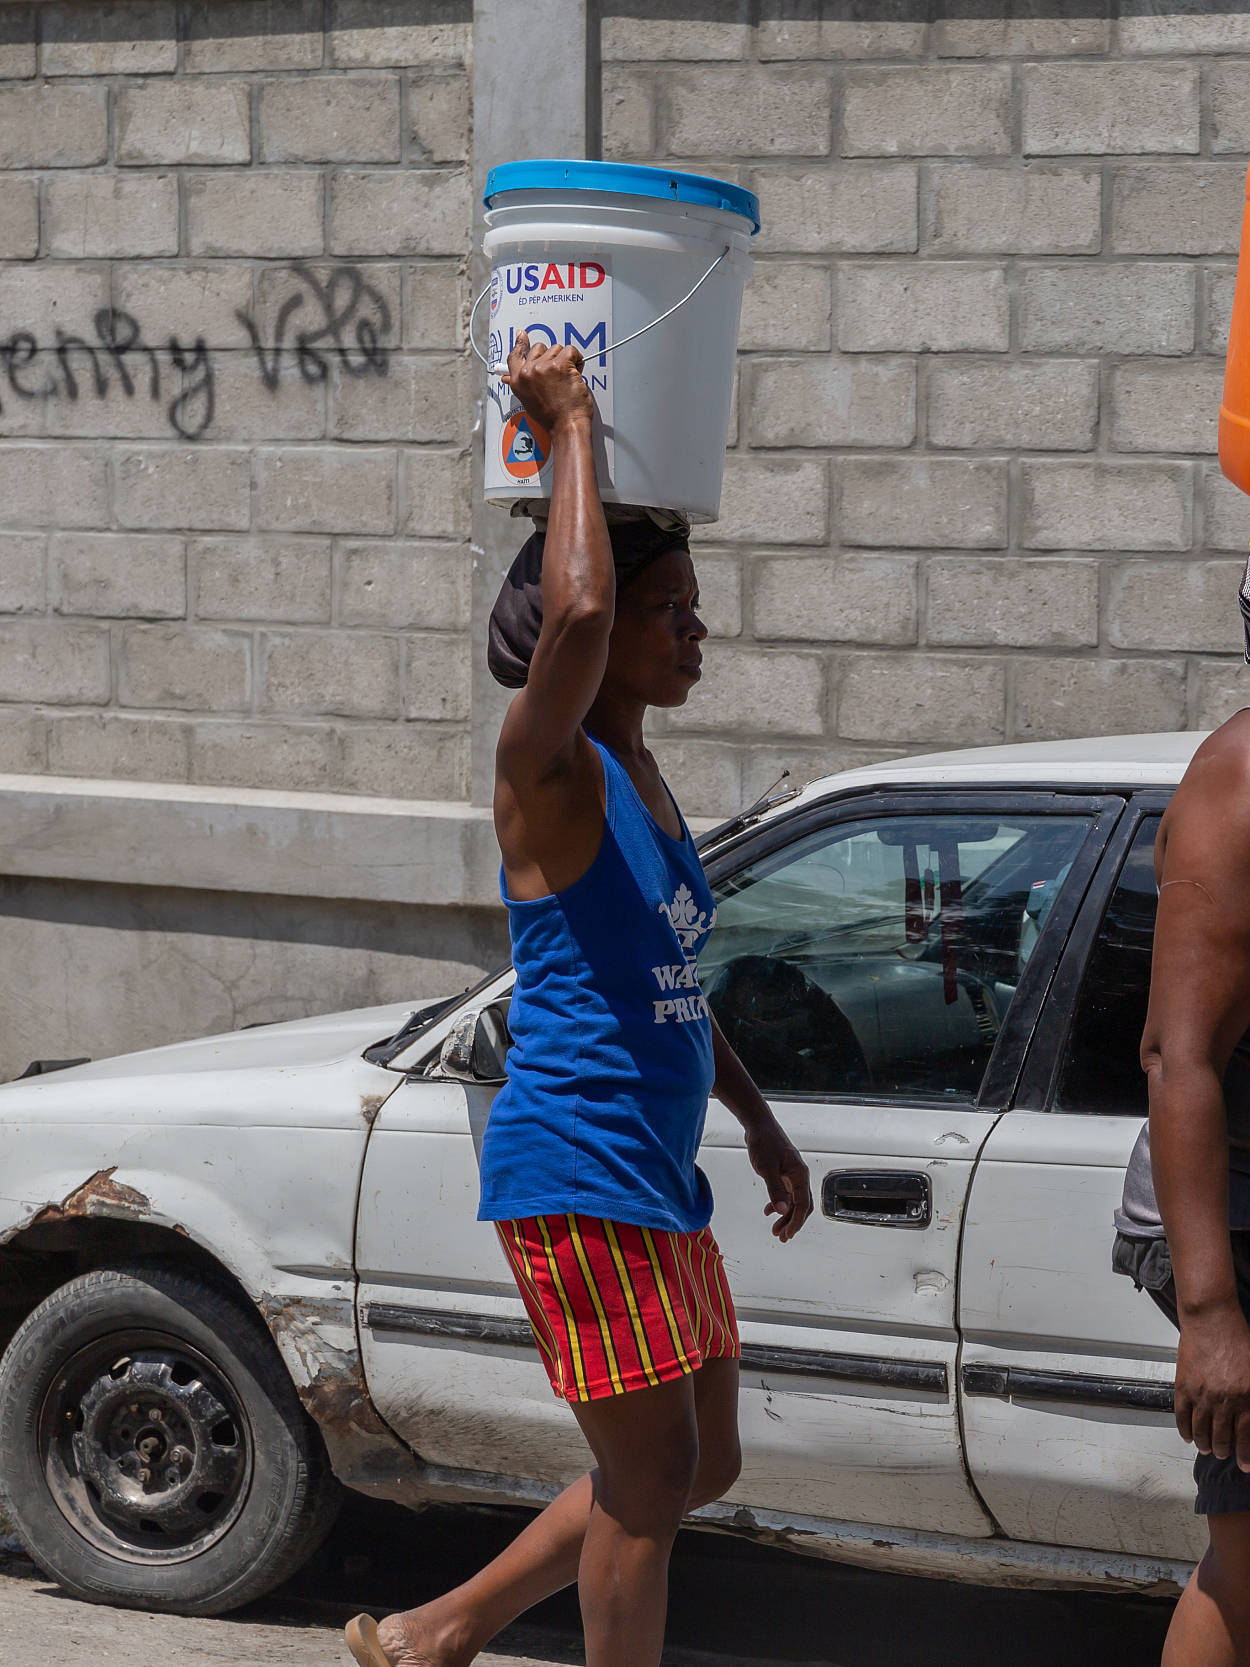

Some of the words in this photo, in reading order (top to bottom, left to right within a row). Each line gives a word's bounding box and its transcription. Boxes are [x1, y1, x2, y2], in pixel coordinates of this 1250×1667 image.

[506, 262, 606, 294] USAID
[541, 294, 584, 304] AMERIKEN
[651, 963, 699, 992] WA
